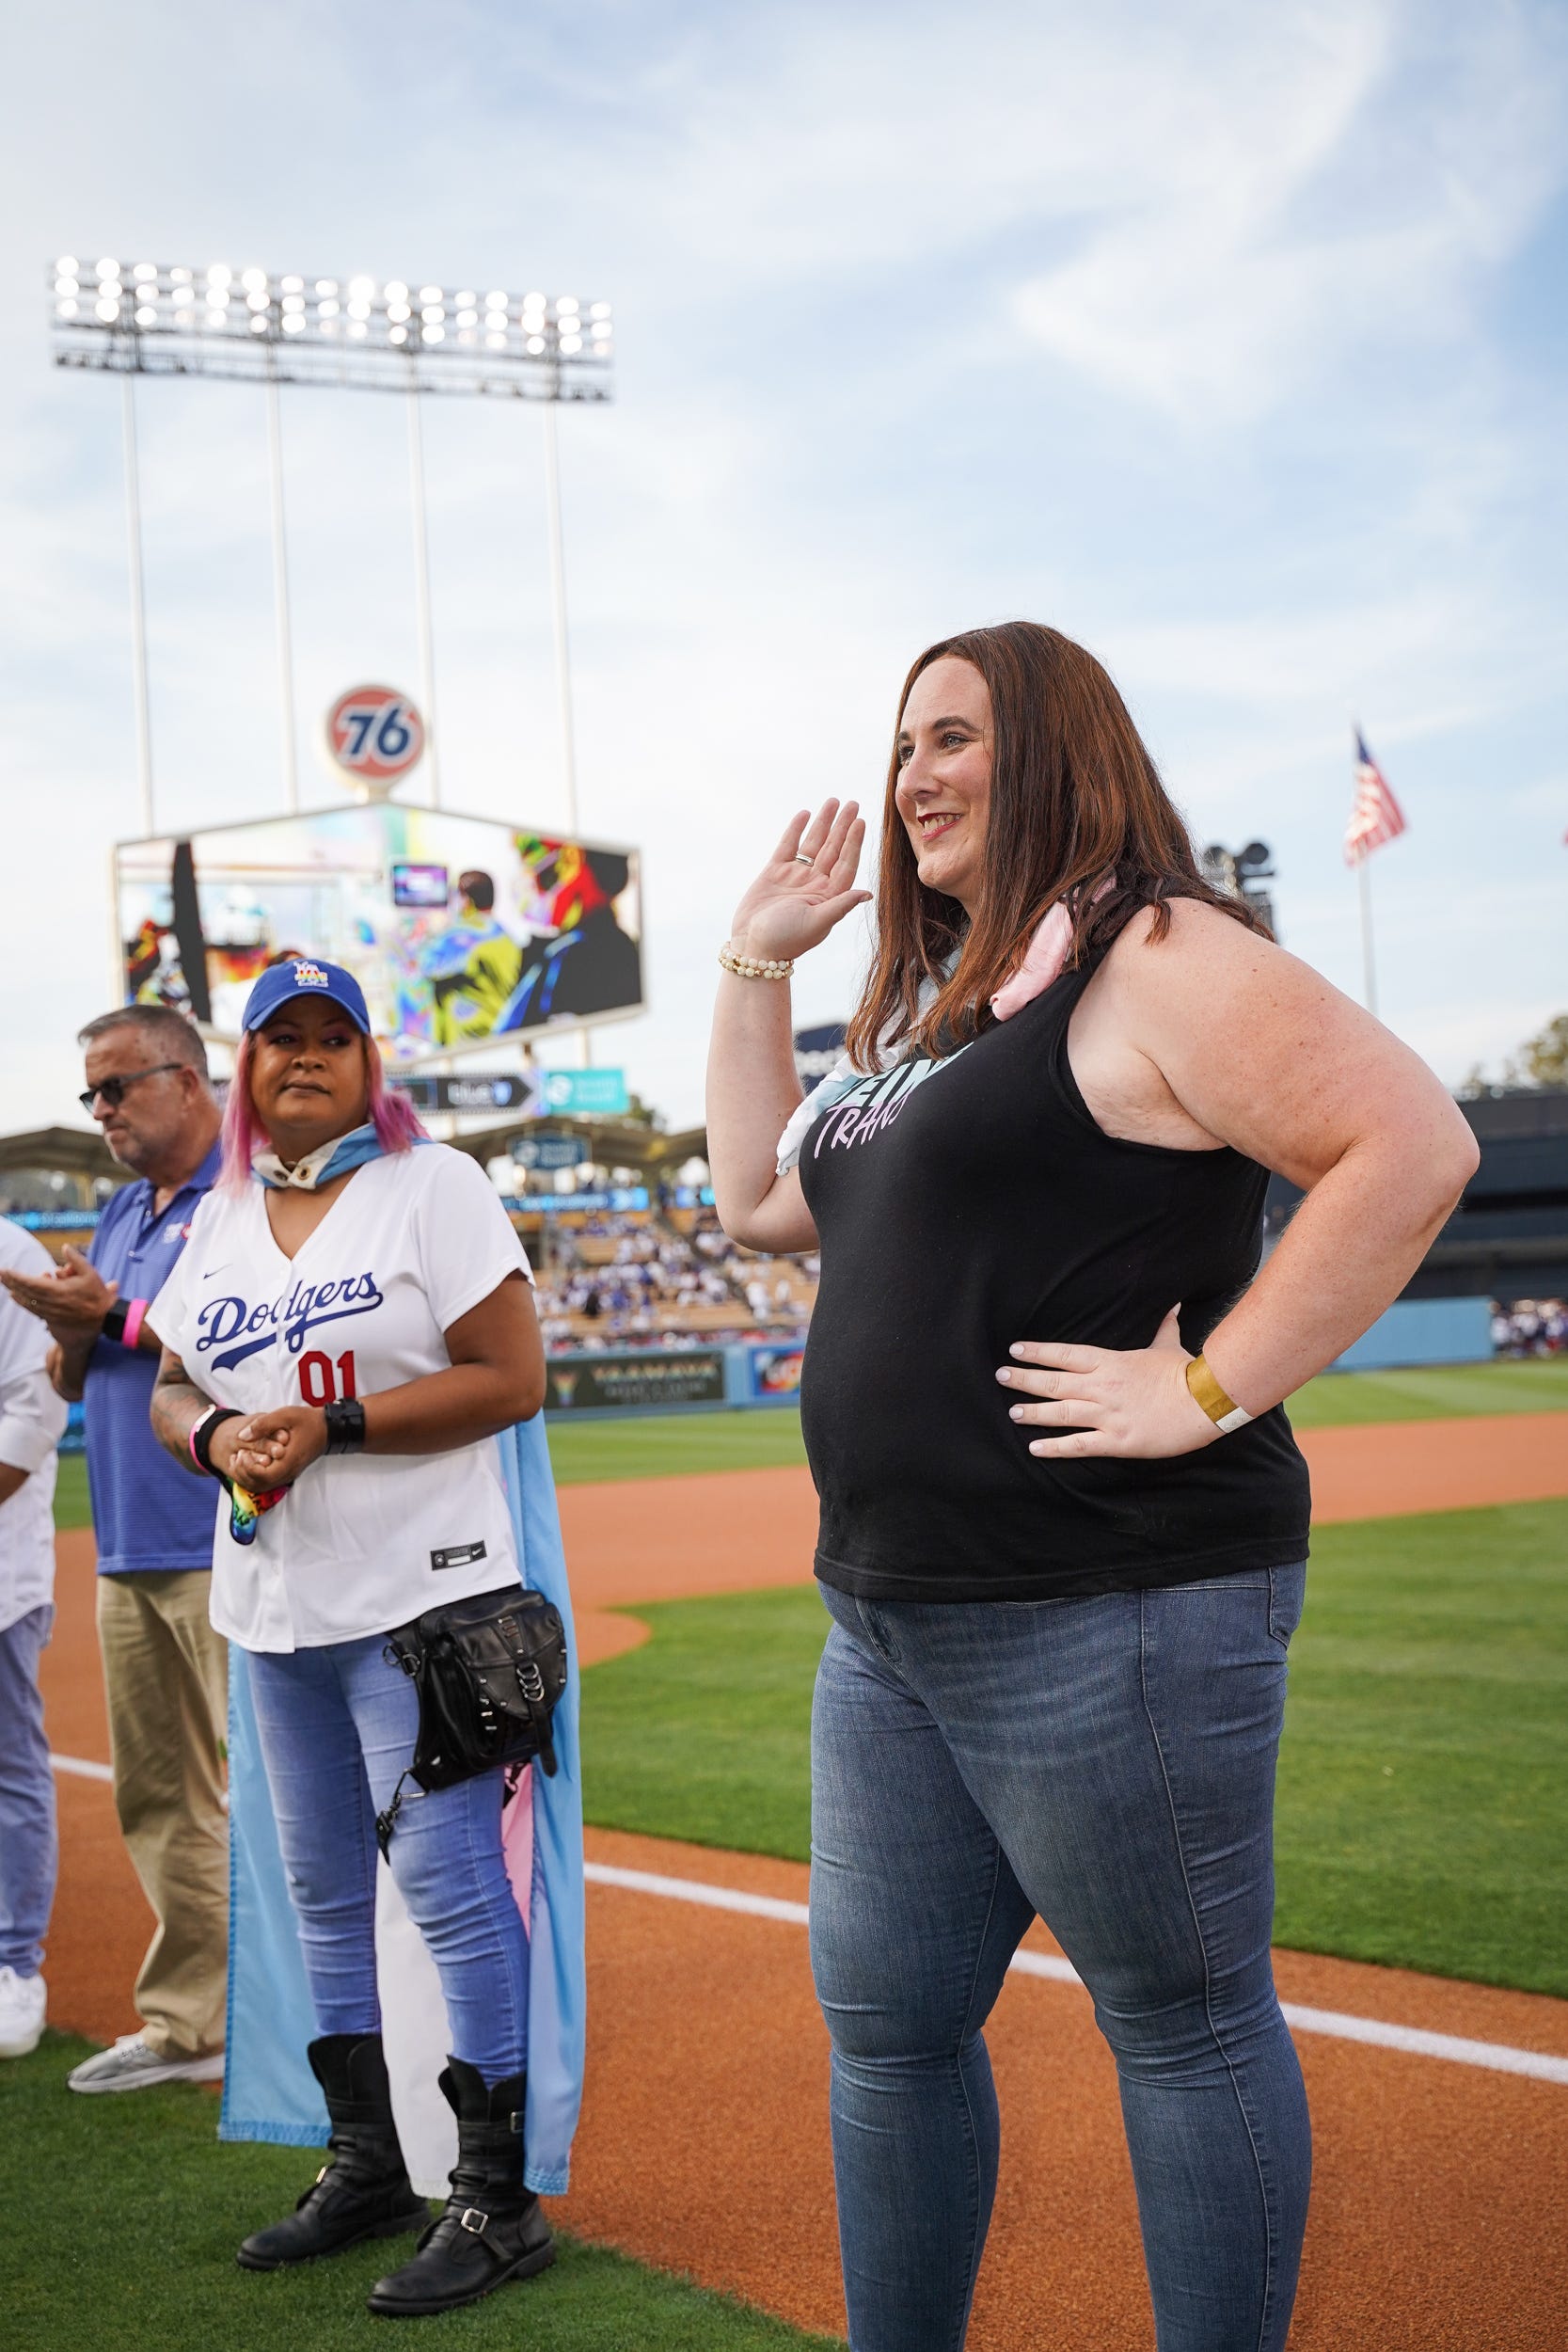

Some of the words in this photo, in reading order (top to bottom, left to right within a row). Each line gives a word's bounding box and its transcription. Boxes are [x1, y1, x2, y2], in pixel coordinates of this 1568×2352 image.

[345, 705, 412, 759] 76
[293, 961, 328, 987] LA
[814, 1092, 911, 1159] TRANS
[196, 1271, 384, 1354] Dodgers
[297, 1349, 356, 1408] 01
